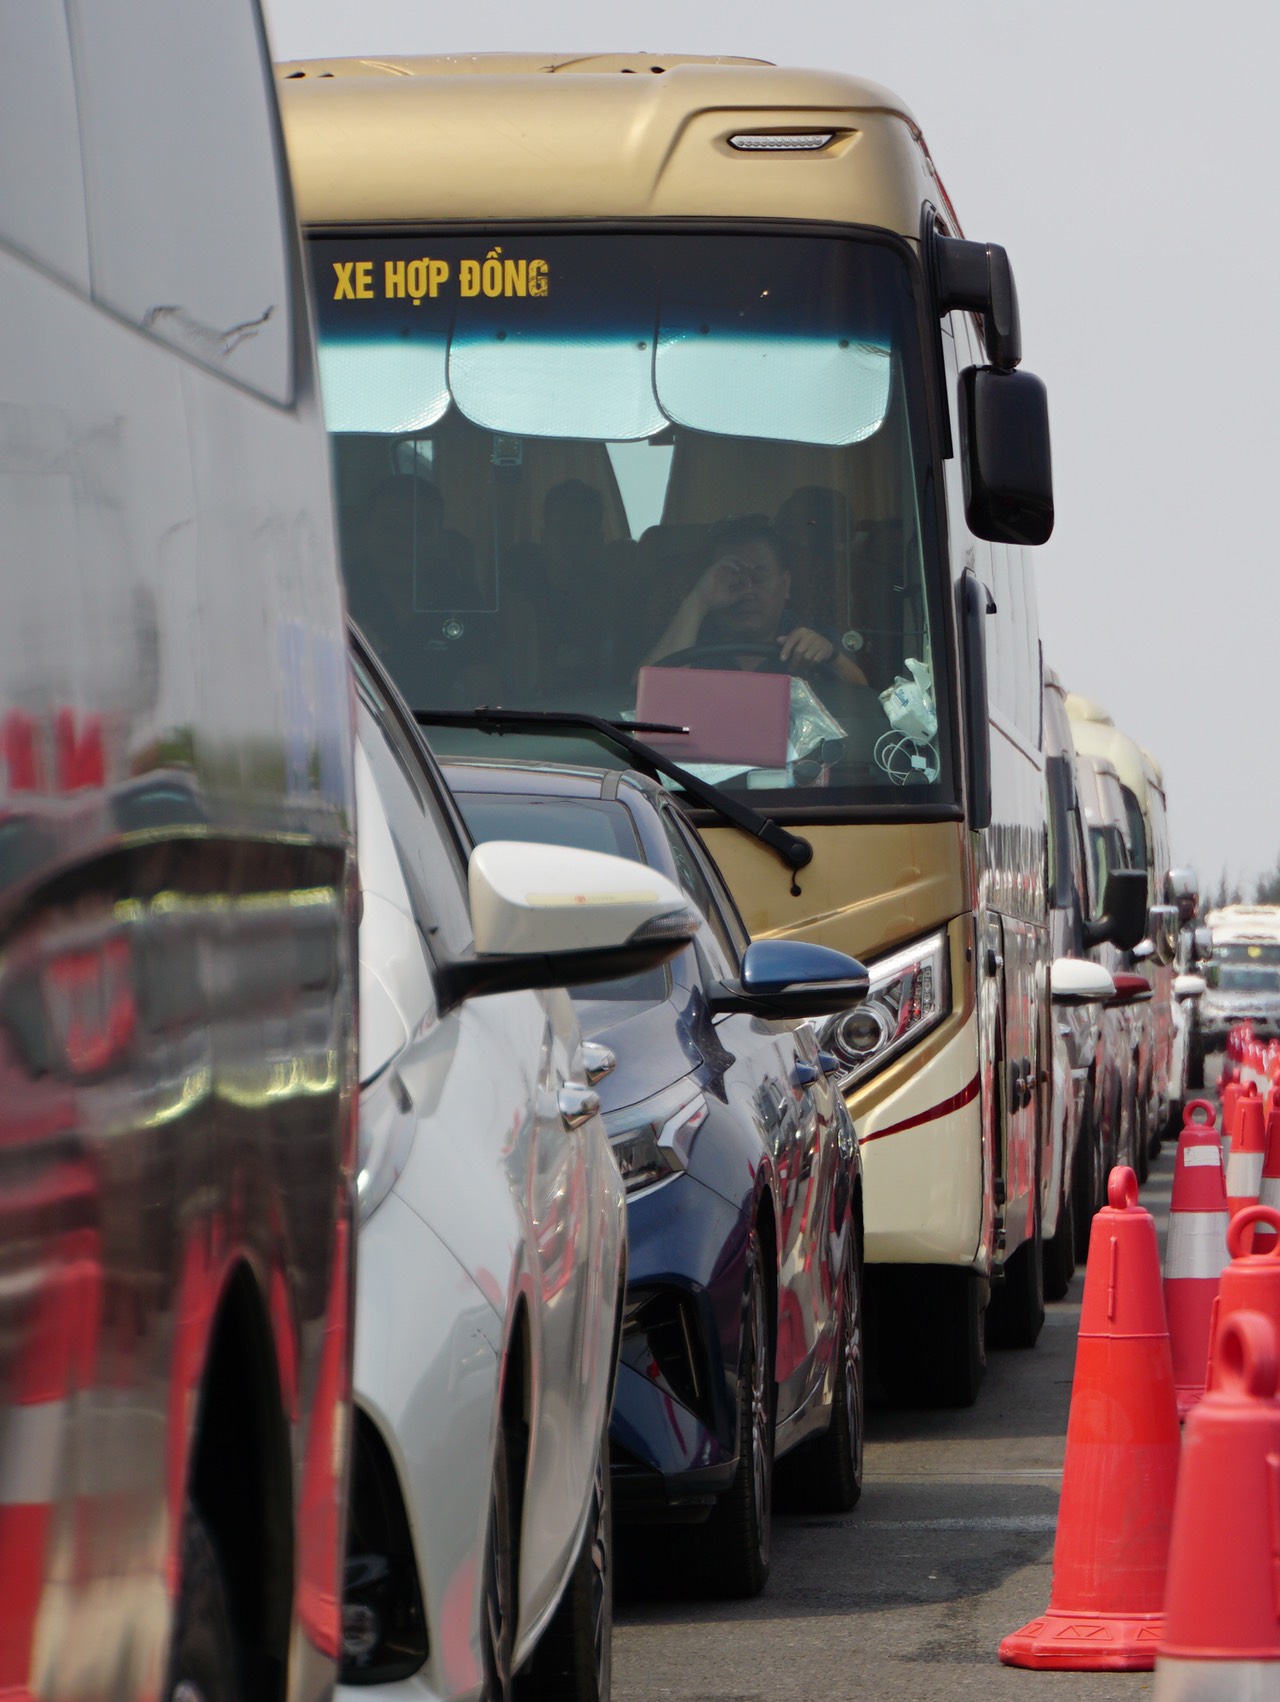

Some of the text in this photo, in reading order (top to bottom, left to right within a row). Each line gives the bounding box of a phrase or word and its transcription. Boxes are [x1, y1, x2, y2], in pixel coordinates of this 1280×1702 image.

[333, 247, 549, 306] XE HỢP ĐỒNG
